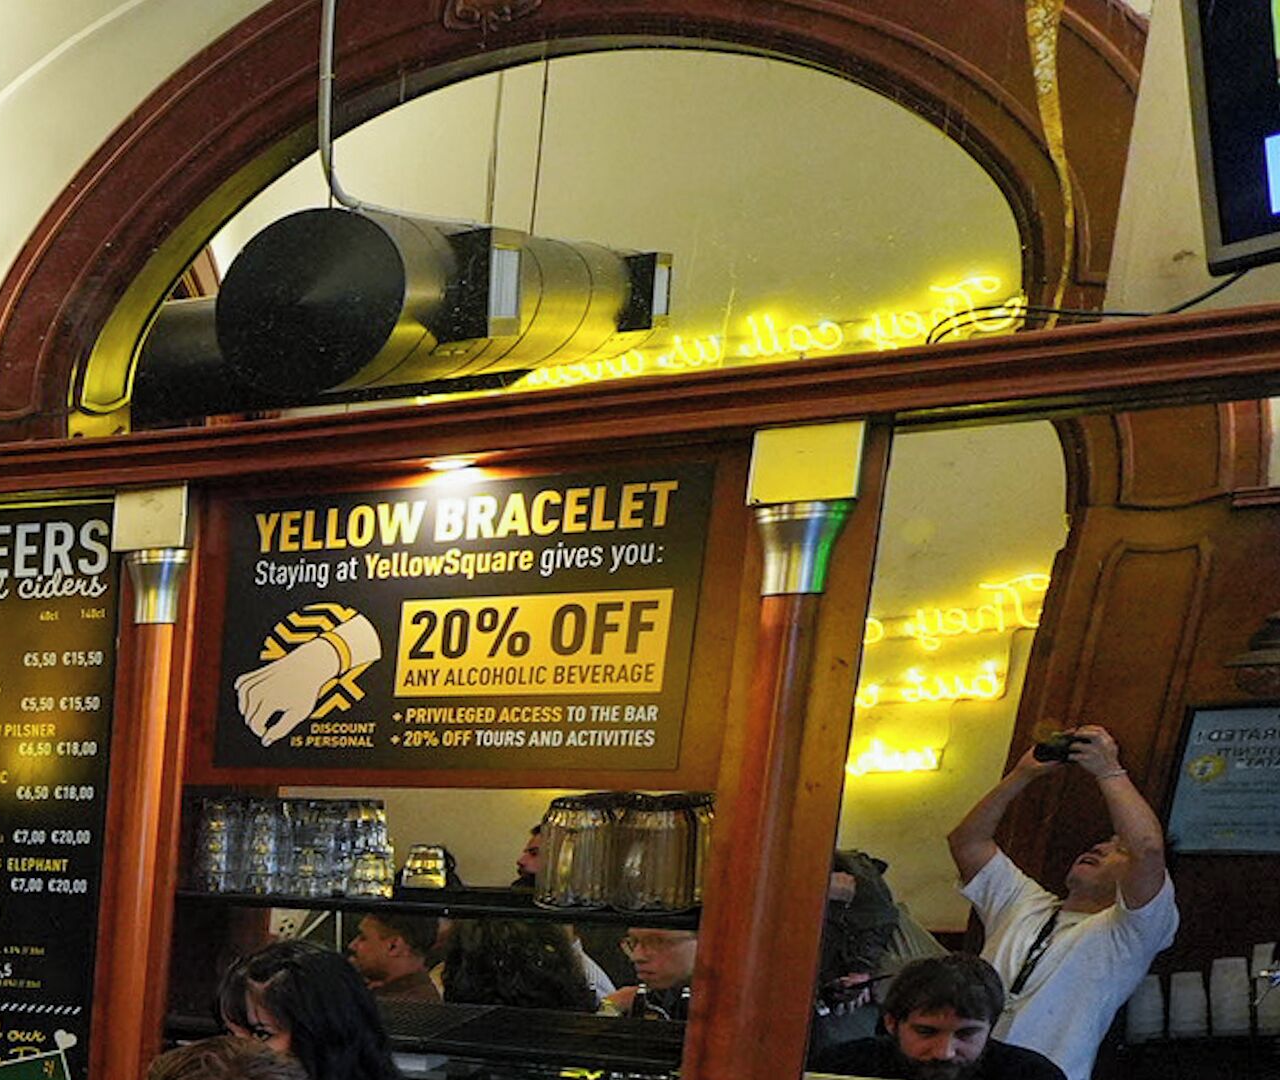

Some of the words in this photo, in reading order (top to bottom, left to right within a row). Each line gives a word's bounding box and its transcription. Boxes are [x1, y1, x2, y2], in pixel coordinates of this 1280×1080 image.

[255, 500, 427, 553] YELLOW
[434, 480, 679, 543] BRACELET
[254, 558, 330, 590] Staying
[335, 557, 359, 580] at
[365, 547, 534, 580] YellowSquare
[540, 542, 603, 576] gives
[609, 543, 664, 573] you:
[18, 568, 107, 599] ciders
[408, 606, 531, 660] 20%
[550, 600, 659, 656] OFF
[24, 652, 57, 668] €5,50
[62, 650, 103, 667] €15,50
[403, 668, 441, 687] ANY
[444, 666, 548, 686] ALCOHOLIC
[553, 663, 655, 685] BEVERAGE
[20, 697, 55, 711] €5,50
[59, 696, 101, 711] €15,50
[405, 707, 496, 724] PRIVILEGED
[498, 706, 562, 723] ACCESS
[566, 706, 588, 723] TO
[590, 706, 620, 722] THE
[623, 705, 658, 722] BAR
[4, 723, 56, 738] PILSNER
[310, 723, 376, 735] DISCOUNT
[290, 736, 303, 747] IS
[305, 735, 373, 747] PERSONAL
[402, 730, 439, 747] 20%
[442, 730, 472, 746] OFF
[474, 730, 526, 747] TOURS
[528, 730, 563, 747] AND
[565, 730, 655, 747] ACTIVITIES
[18, 742, 52, 756] €6,50
[56, 741, 98, 756] €18,00
[15, 785, 49, 800] €6,50
[54, 785, 94, 801] €18,00
[12, 829, 46, 845] €7,00
[51, 829, 91, 846] €20,00
[6, 857, 69, 872] ELEPHANT
[10, 878, 43, 893] €7,00
[48, 878, 87, 894] €20,00
[7, 1029, 46, 1042] our
